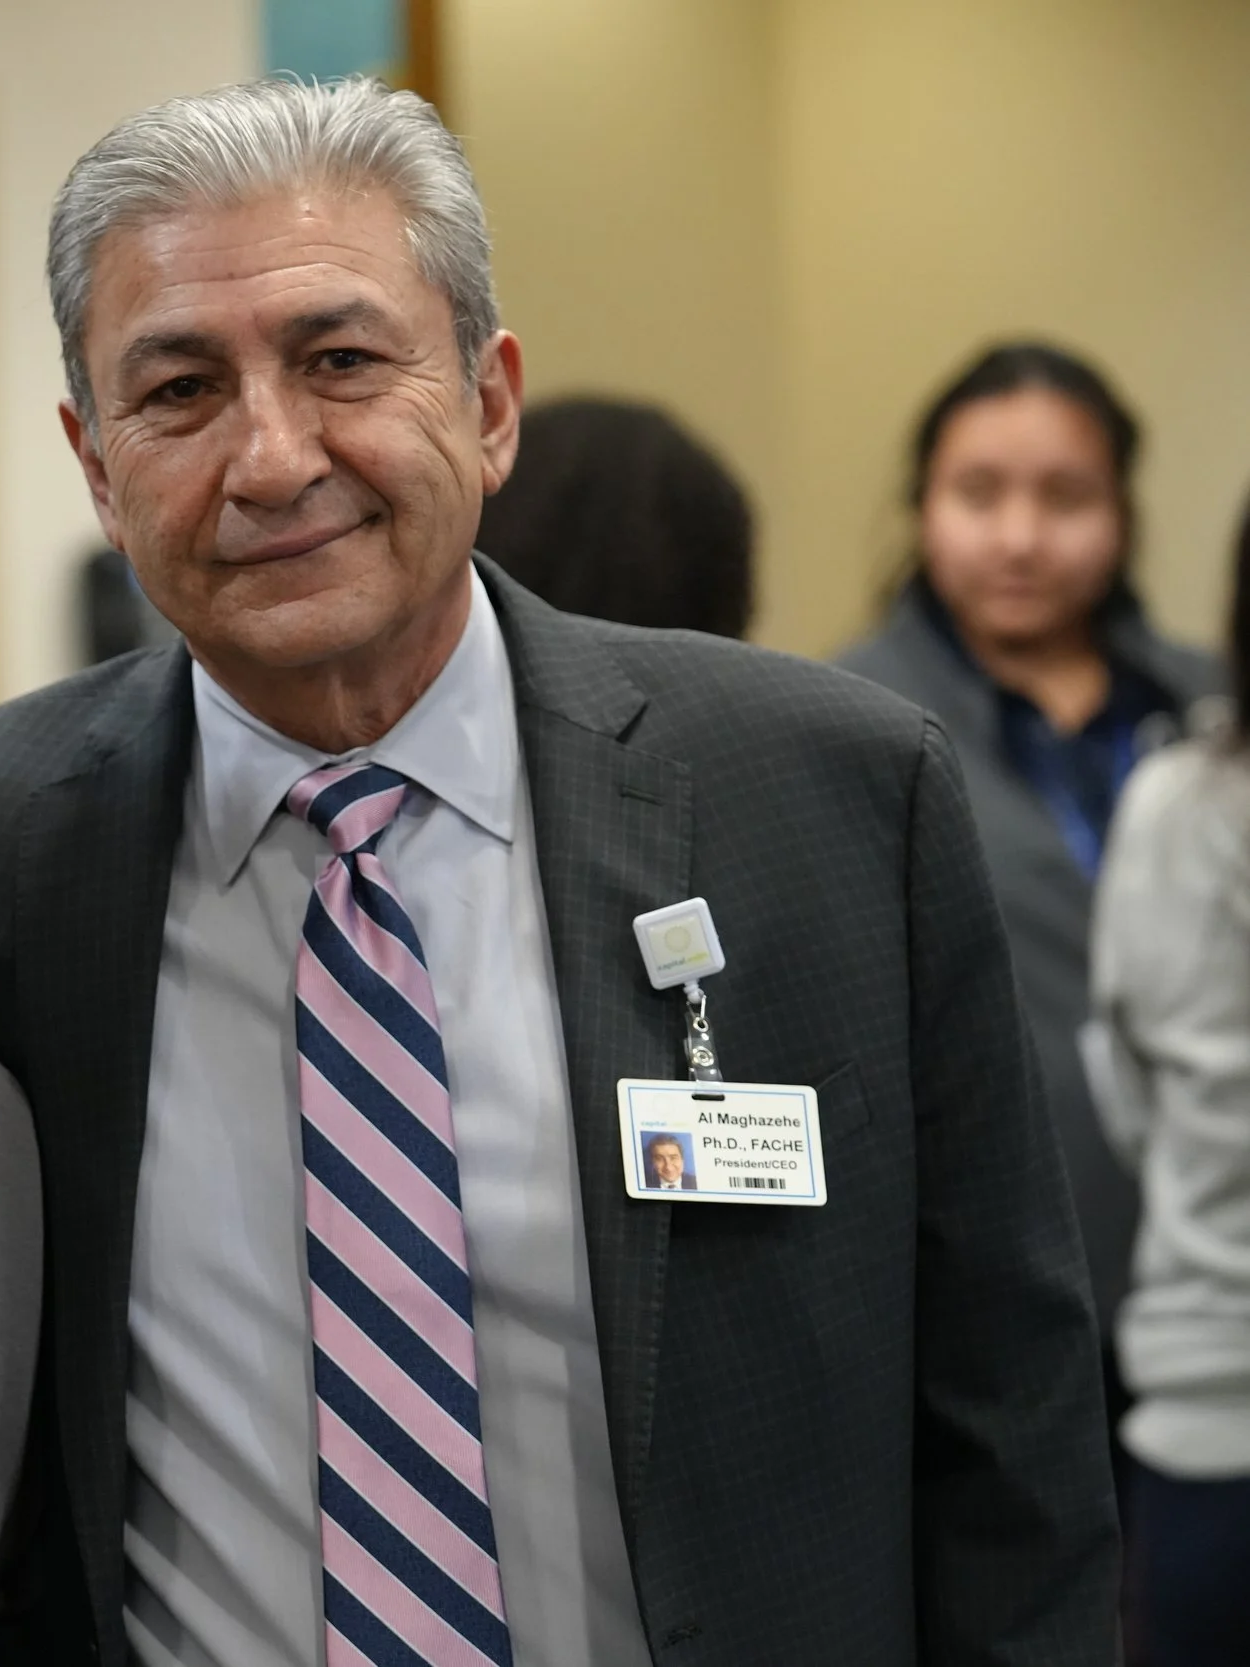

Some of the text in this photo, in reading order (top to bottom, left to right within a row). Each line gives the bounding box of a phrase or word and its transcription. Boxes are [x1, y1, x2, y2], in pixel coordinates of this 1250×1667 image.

[698, 1112, 801, 1129] Al Maghazehe
[702, 1136, 804, 1152] Ph.D., FACHE
[714, 1158, 798, 1170] President/CEO
